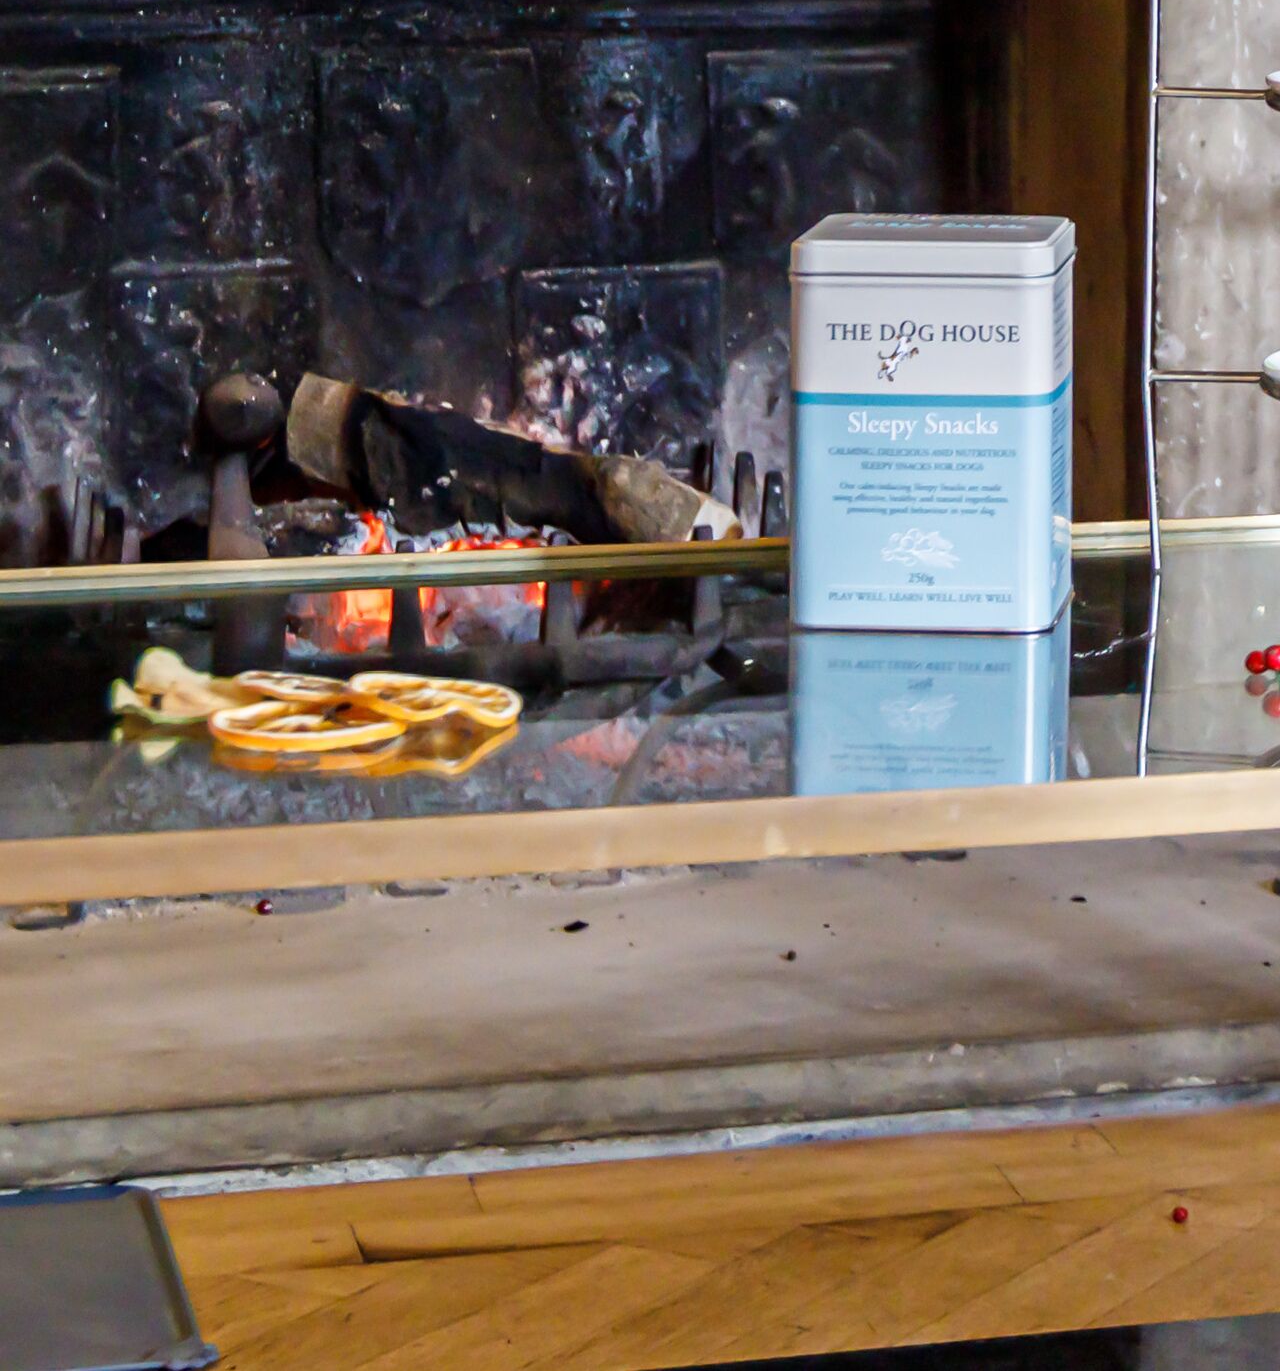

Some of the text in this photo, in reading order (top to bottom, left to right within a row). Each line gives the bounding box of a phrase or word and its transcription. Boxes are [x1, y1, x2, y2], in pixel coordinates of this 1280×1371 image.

[826, 320, 1020, 343] THE DOG HOUSE
[848, 411, 999, 441] Sleepy Snacks
[932, 449, 953, 457] AND
[955, 449, 1016, 458] NUTRITIOUS
[861, 461, 984, 471] SLEEPY SNACKS FOR DOGS
[908, 573, 935, 586] 250g
[828, 592, 852, 601] PLAY
[889, 592, 923, 602] LEARN
[959, 594, 982, 603] LIVE
